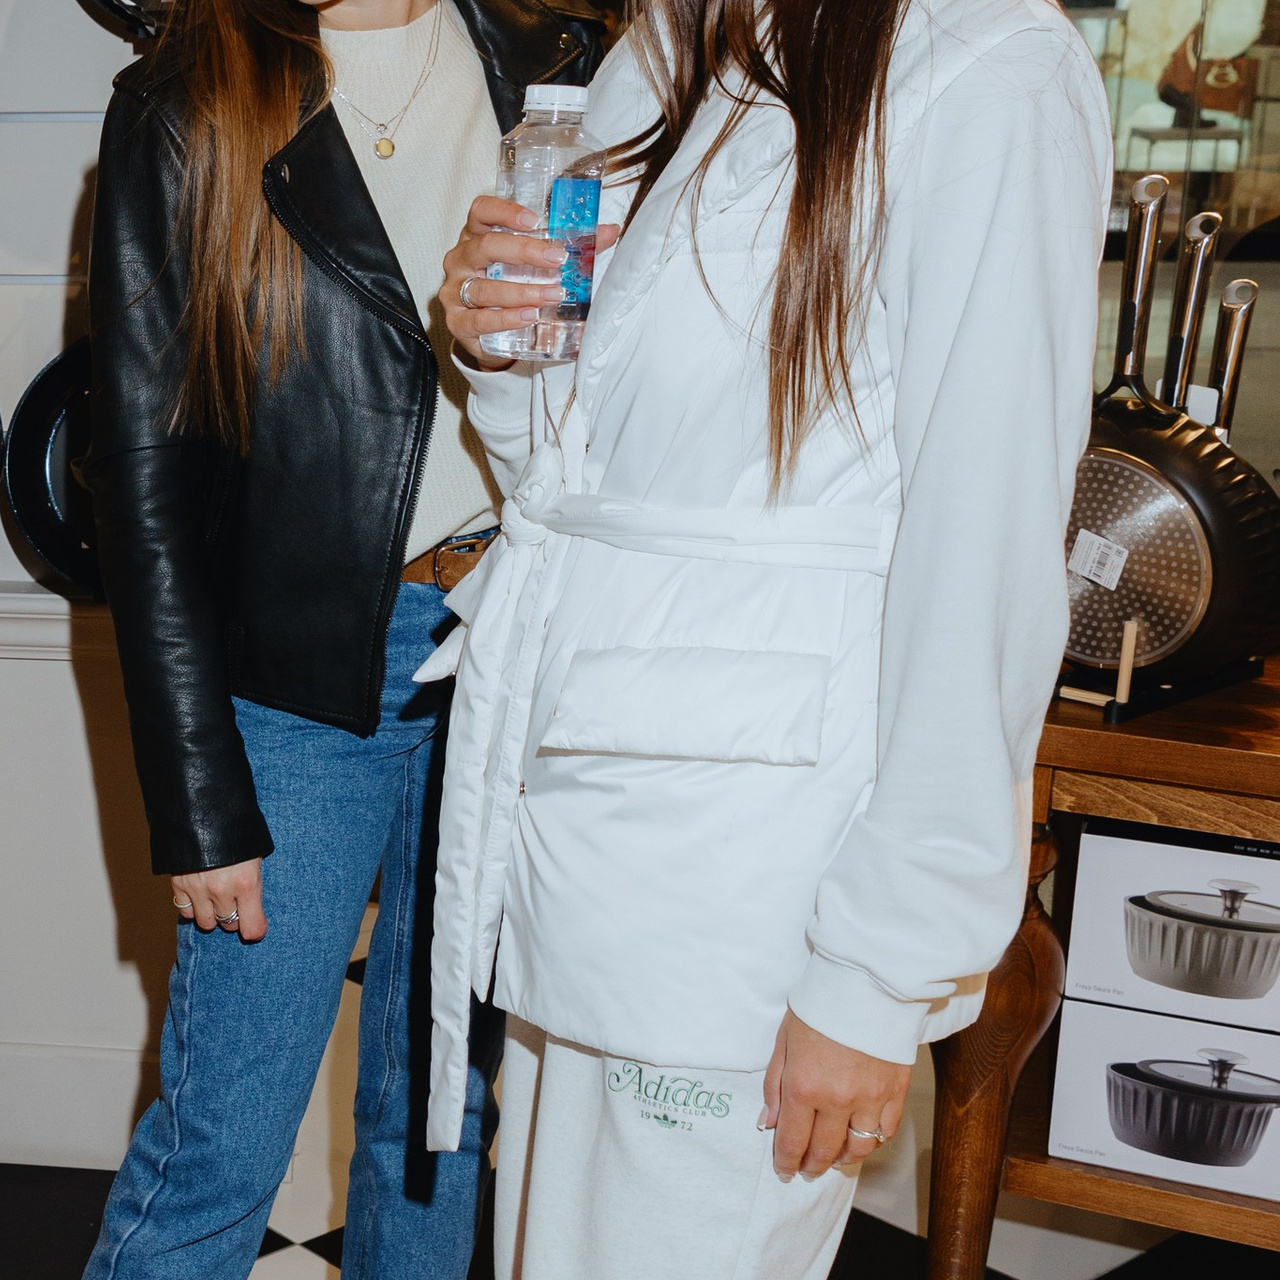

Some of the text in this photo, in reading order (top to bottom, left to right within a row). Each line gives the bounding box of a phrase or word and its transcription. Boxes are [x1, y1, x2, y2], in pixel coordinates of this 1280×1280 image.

[1093, 985, 1111, 993] Sauce
[608, 1061, 732, 1118] Adidas
[633, 1094, 707, 1117] ATHLETICS CLUB
[640, 1110, 693, 1131] 19 72
